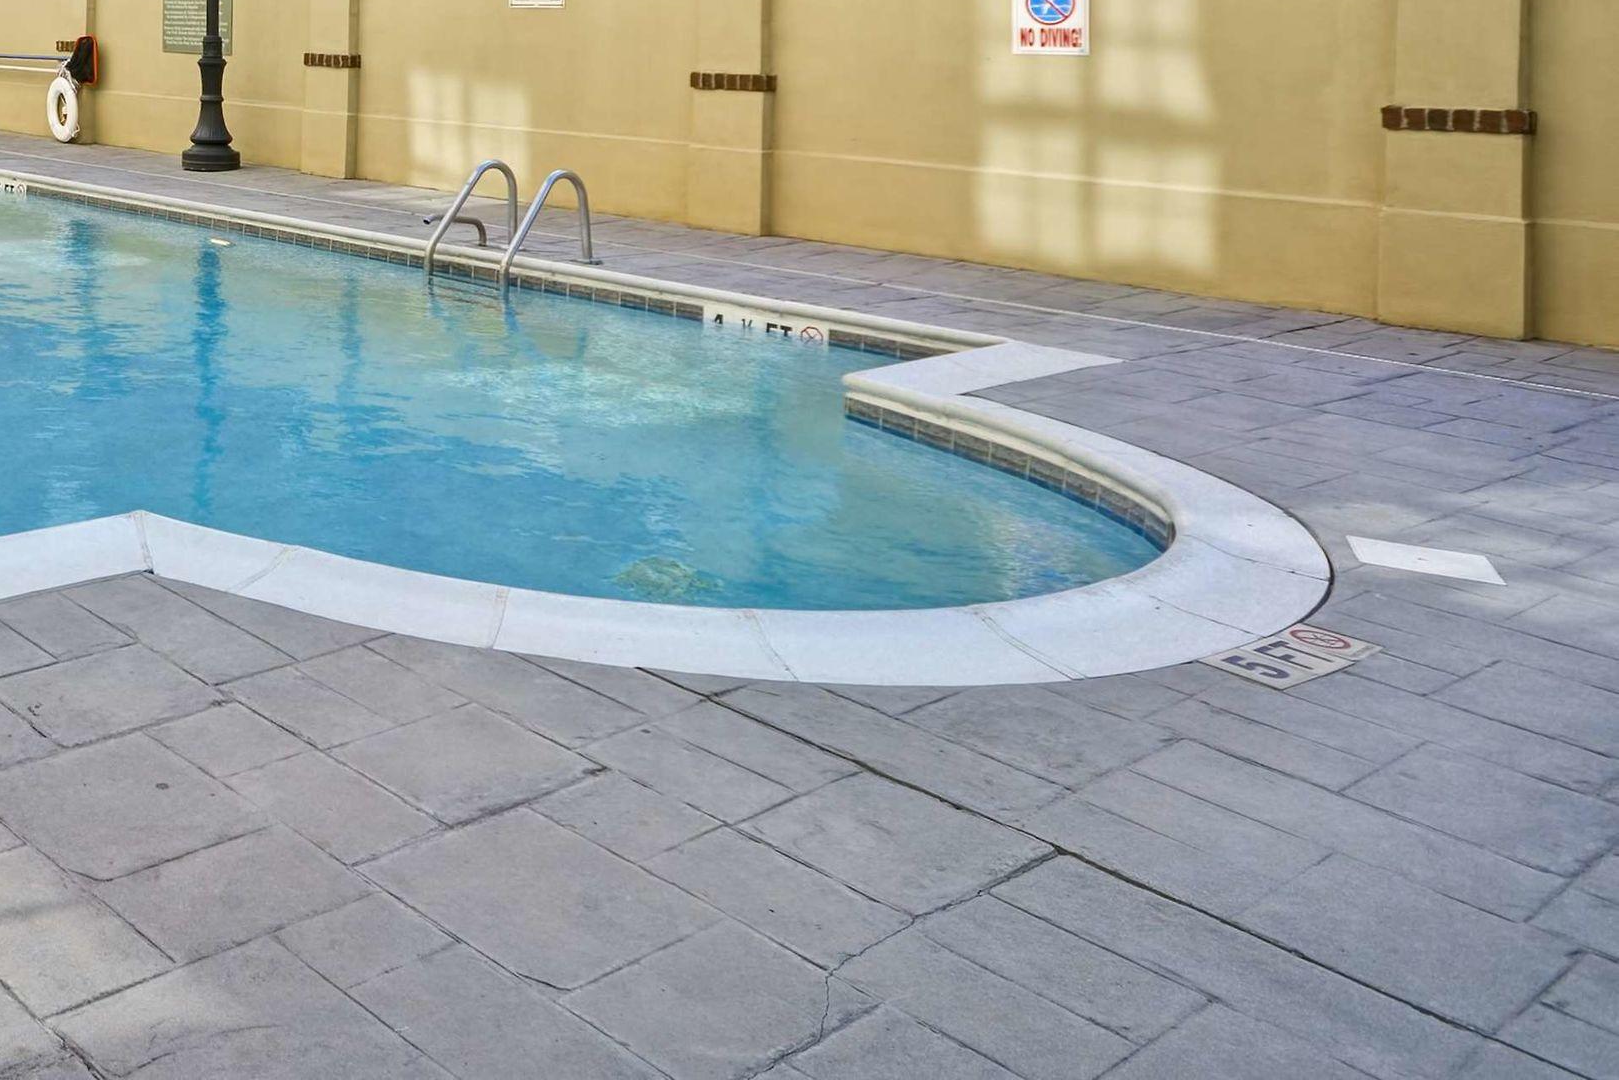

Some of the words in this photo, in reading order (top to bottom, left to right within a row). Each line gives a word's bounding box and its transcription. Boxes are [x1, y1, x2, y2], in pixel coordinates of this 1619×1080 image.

[1020, 28, 1035, 47] NO
[1041, 28, 1082, 47] DIVING!
[766, 322, 792, 336] FT
[1253, 640, 1334, 670] FT
[1221, 655, 1290, 679] 5
